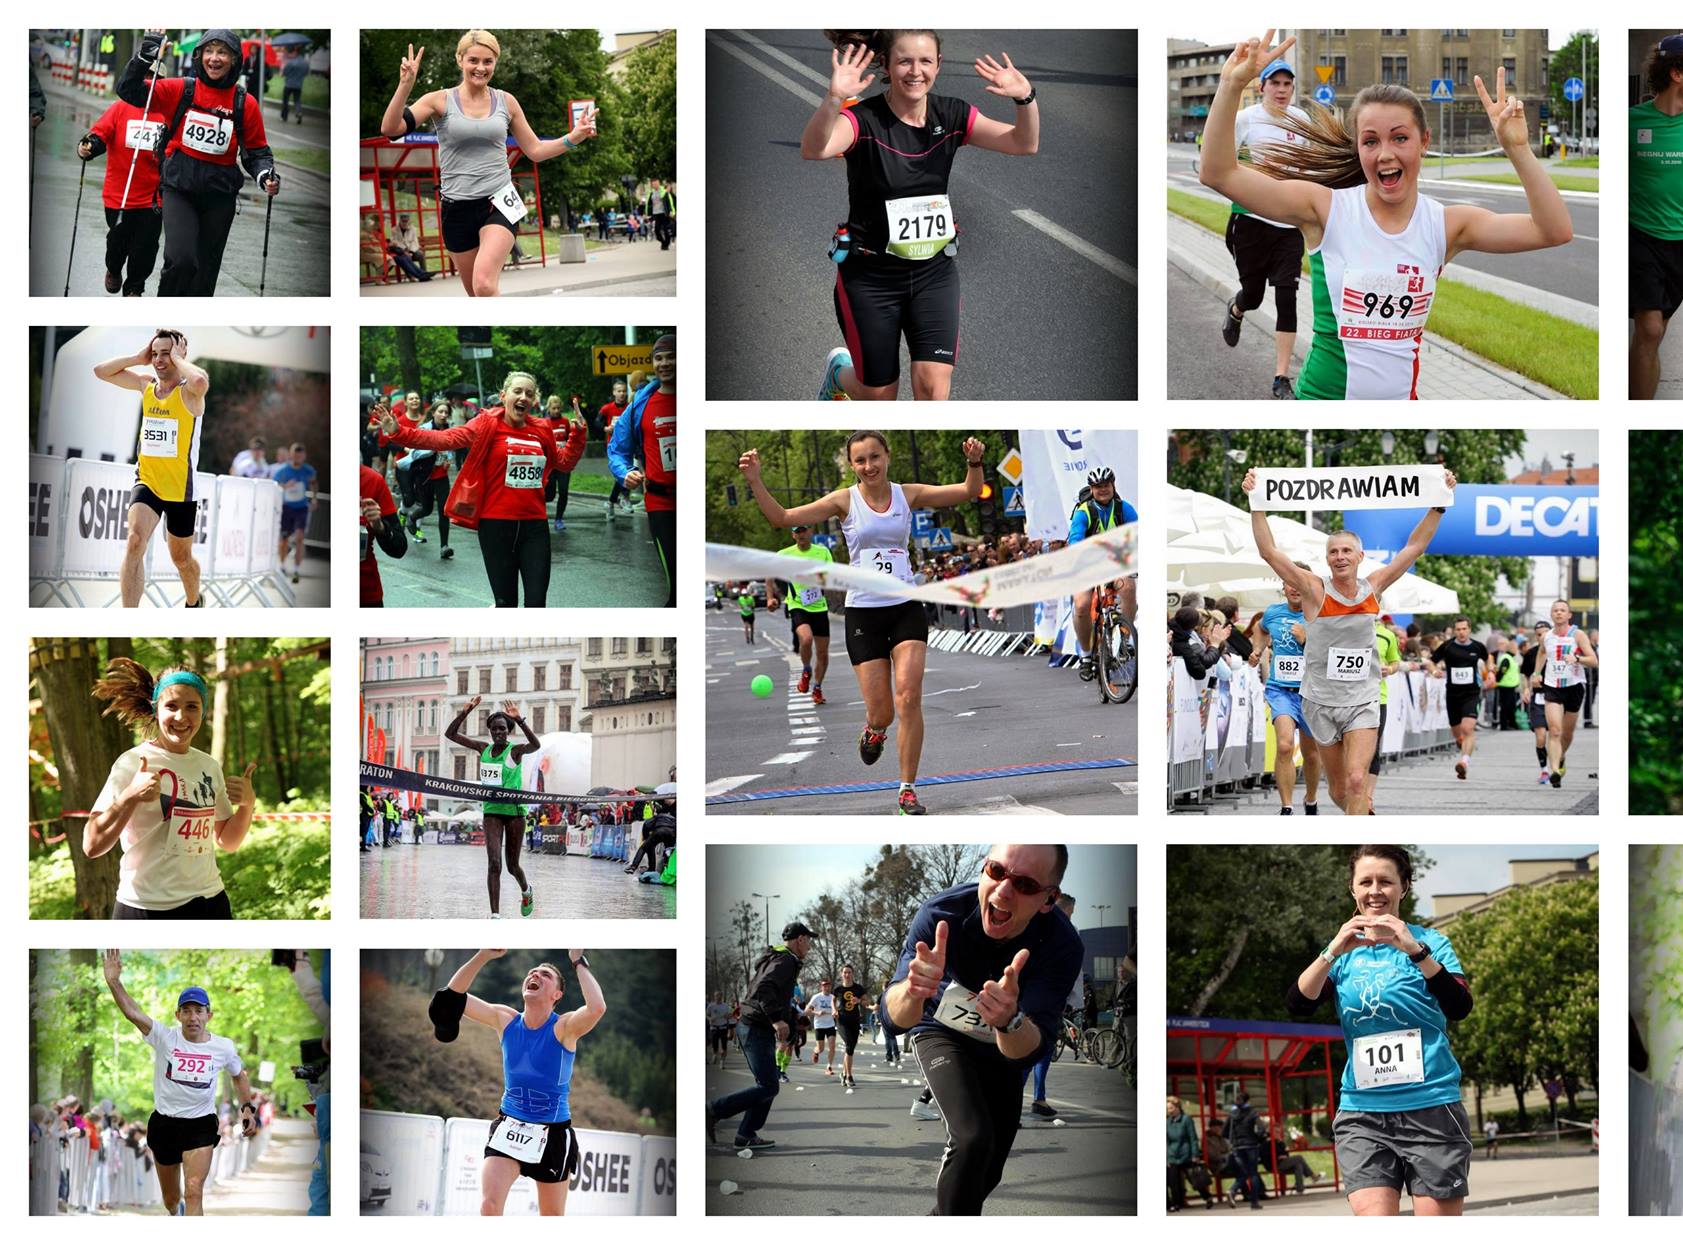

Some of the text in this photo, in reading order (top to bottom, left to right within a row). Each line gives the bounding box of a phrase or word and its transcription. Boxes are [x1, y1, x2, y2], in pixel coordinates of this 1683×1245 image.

[186, 125, 227, 147] 4928
[899, 214, 946, 240] 2179
[1363, 292, 1414, 319] 969
[1346, 328, 1362, 337] 22.
[1367, 329, 1391, 338] BIEG
[509, 466, 542, 480] 4858
[1265, 475, 1420, 501] POZDRAWIAM
[79, 486, 131, 540] OSHE
[1279, 661, 1299, 671] 882
[1336, 655, 1364, 669] 750
[424, 777, 494, 799] KRAKOWSKIE
[177, 818, 210, 840] 446
[952, 1004, 987, 1027] 73
[177, 1058, 205, 1073] 292
[1365, 1043, 1405, 1067] 101
[1374, 1065, 1398, 1075] ANNA
[506, 1129, 533, 1145] 6117
